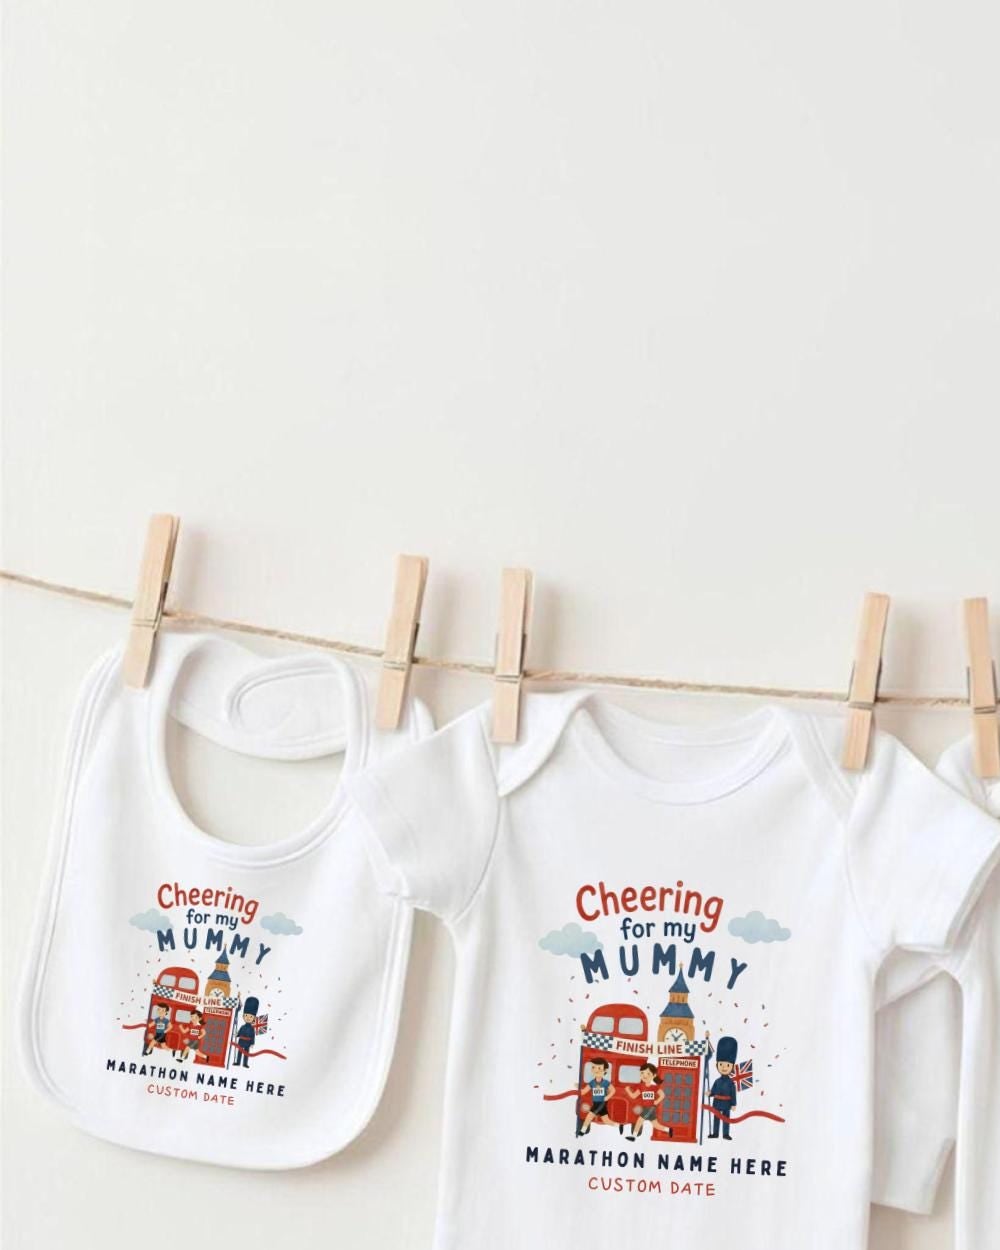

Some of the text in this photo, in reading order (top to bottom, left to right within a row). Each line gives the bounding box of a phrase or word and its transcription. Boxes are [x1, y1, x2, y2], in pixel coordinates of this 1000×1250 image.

[157, 883, 259, 924] Cheering
[576, 881, 724, 932] Cheering
[186, 909, 238, 930] for my
[621, 918, 696, 943] for my
[157, 928, 271, 964] MUMMY
[580, 943, 748, 989] MUMMY
[175, 992, 220, 1006] FINISH LINE
[616, 1041, 682, 1054] FINISH LINE
[662, 1059, 696, 1067] TELEPHONE
[106, 1059, 285, 1096] MARATHON NAME HERE
[147, 1084, 235, 1105] CUSTOM DATE
[526, 1146, 787, 1176] MARATHON NAME HERE
[588, 1177, 715, 1196] CUSTOM DATE
